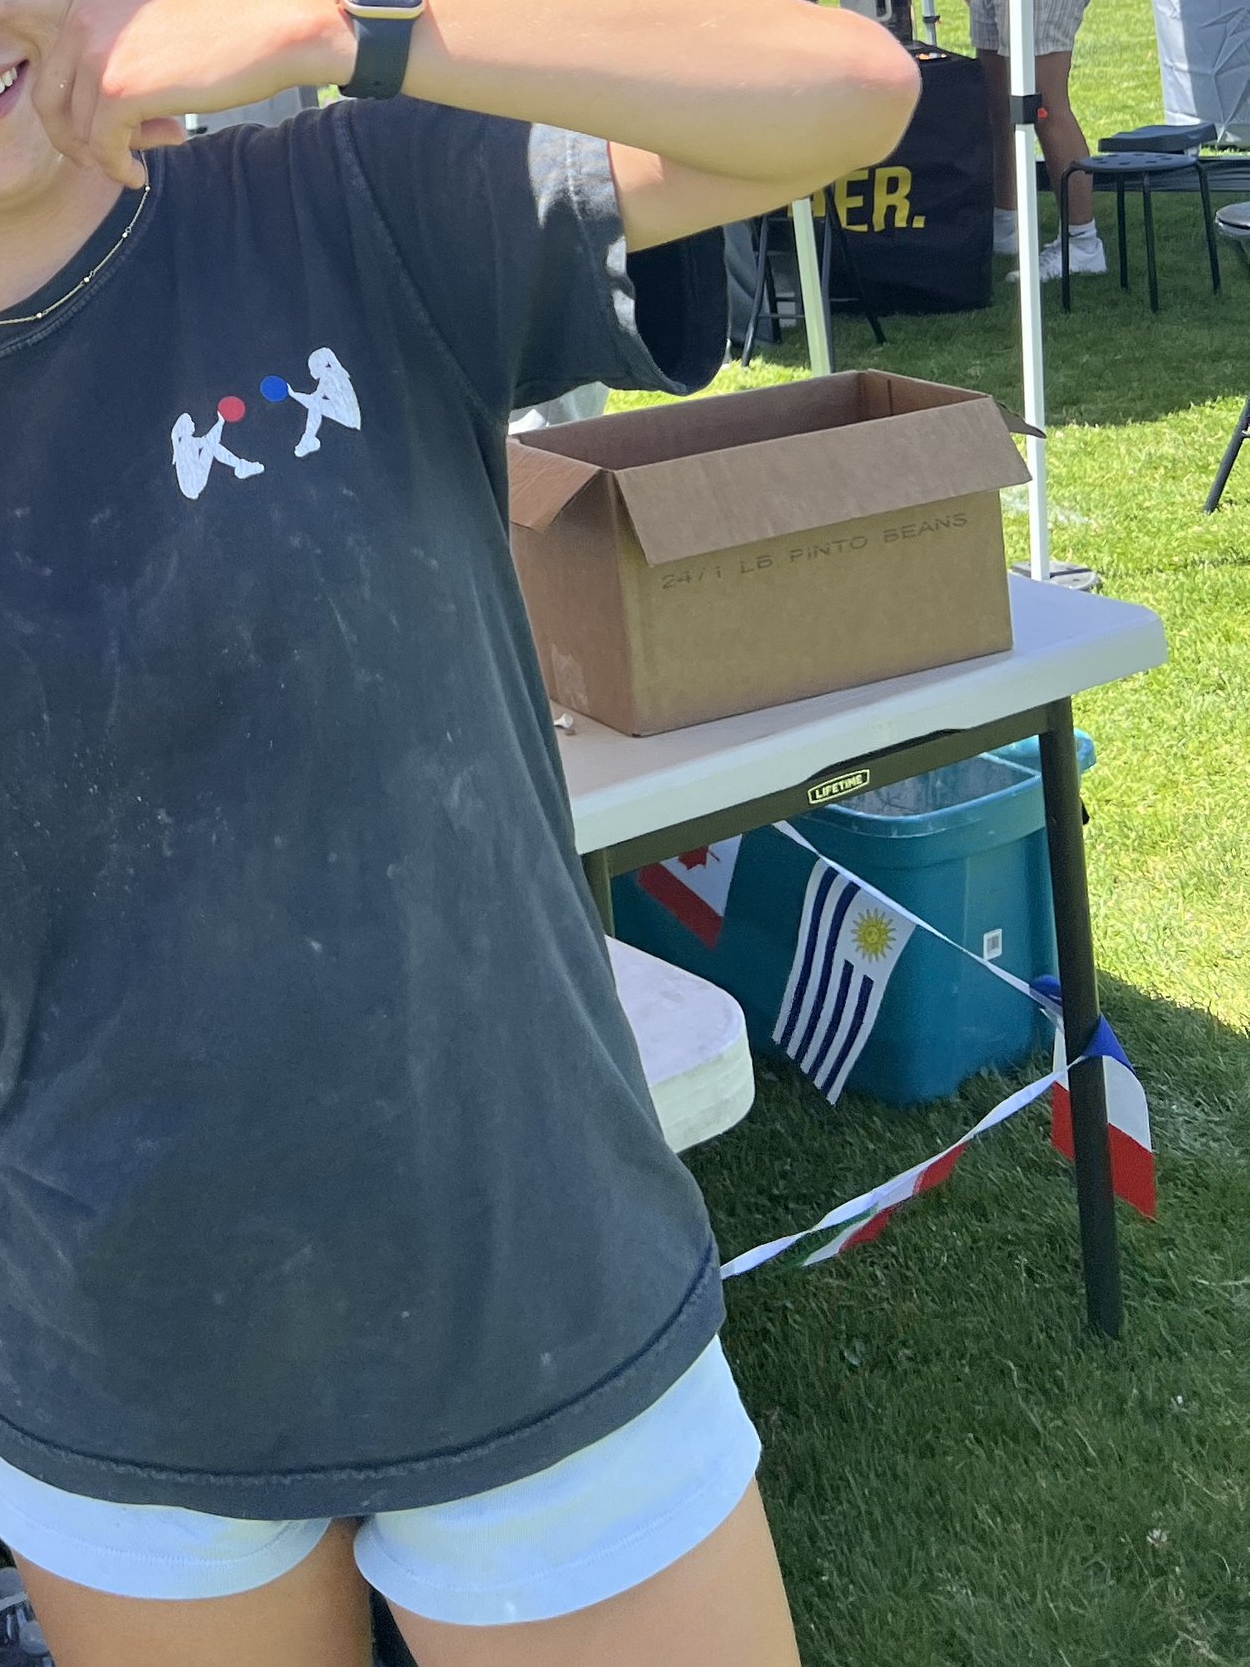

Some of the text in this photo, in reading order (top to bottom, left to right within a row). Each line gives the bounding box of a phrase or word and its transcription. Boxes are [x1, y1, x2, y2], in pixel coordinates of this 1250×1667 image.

[740, 554, 774, 575] LB
[788, 535, 869, 564] PINTO
[882, 512, 969, 544] BEANS
[815, 774, 863, 799] LIFETIME
